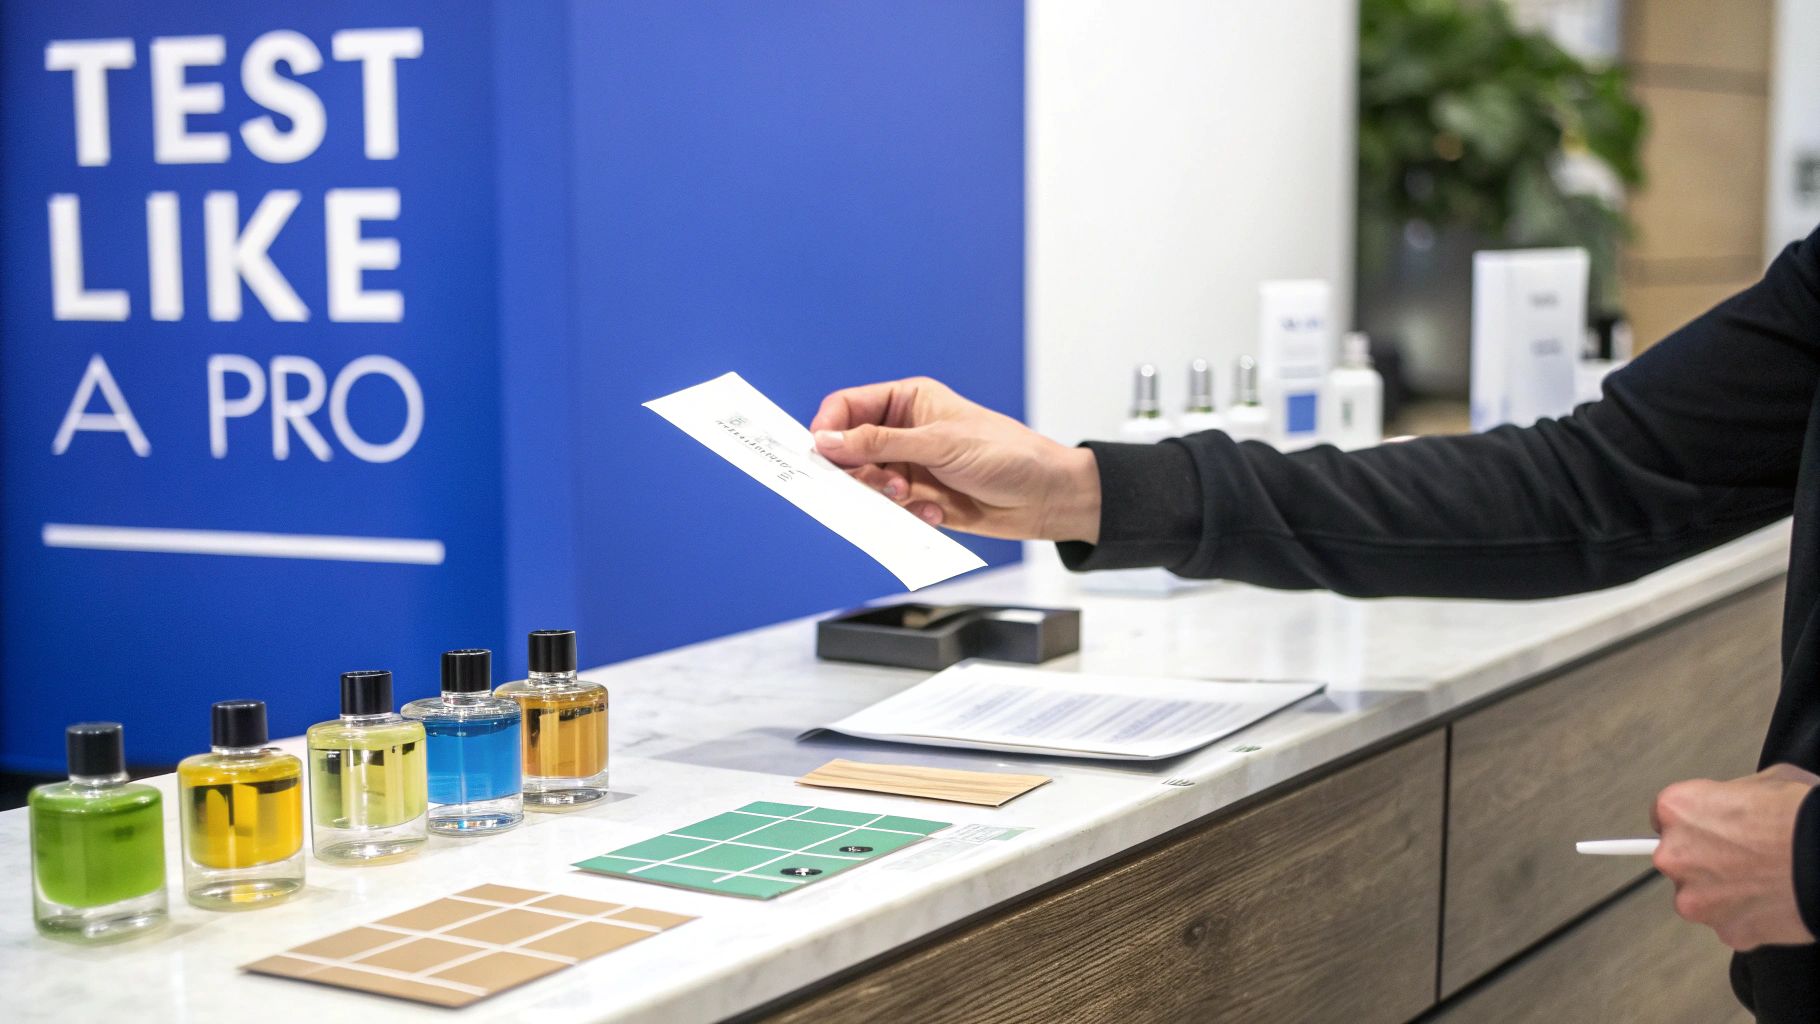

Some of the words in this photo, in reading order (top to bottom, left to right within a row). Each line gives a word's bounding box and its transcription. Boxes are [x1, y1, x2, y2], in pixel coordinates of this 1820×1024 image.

[45, 28, 424, 167] TEST
[48, 188, 404, 323] LIKE
[52, 354, 151, 457] A
[208, 355, 425, 463] PRO
